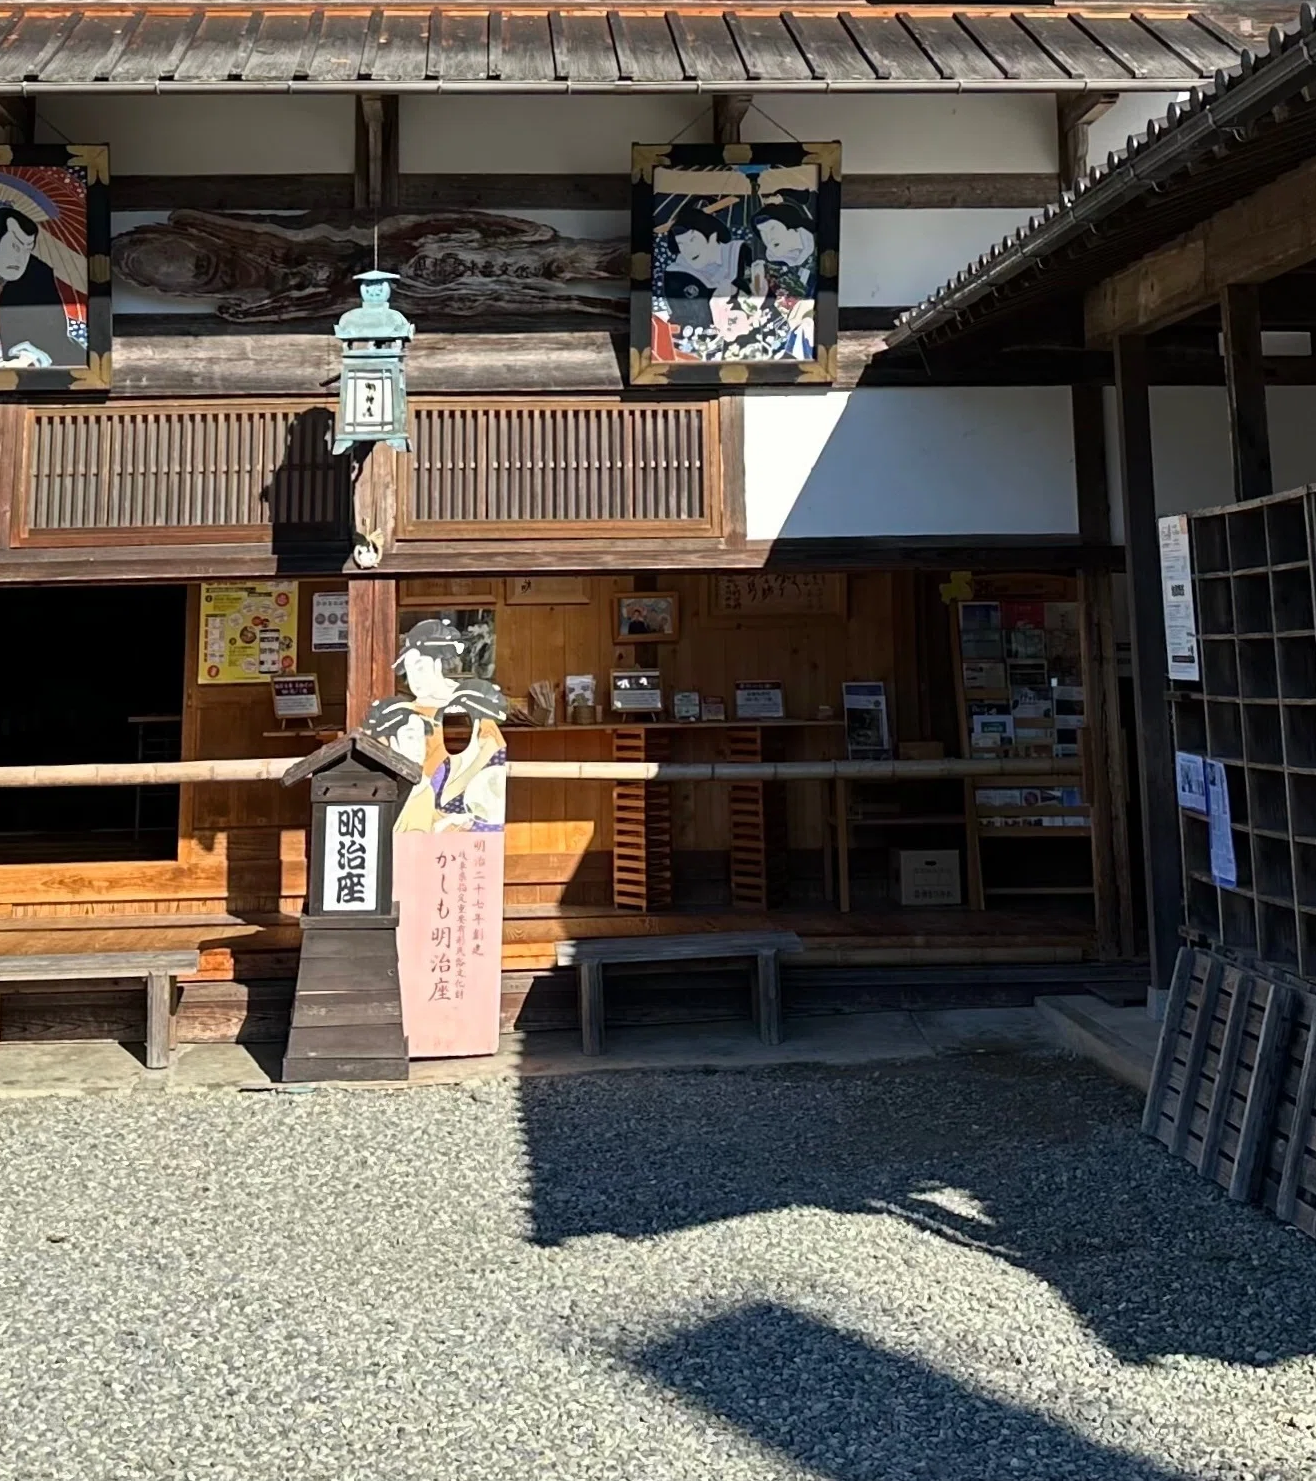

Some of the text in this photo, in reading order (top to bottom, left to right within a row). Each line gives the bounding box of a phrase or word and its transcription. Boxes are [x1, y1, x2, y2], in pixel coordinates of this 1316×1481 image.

[336, 808, 366, 903] 明治座
[428, 851, 456, 1002] かしも明治座
